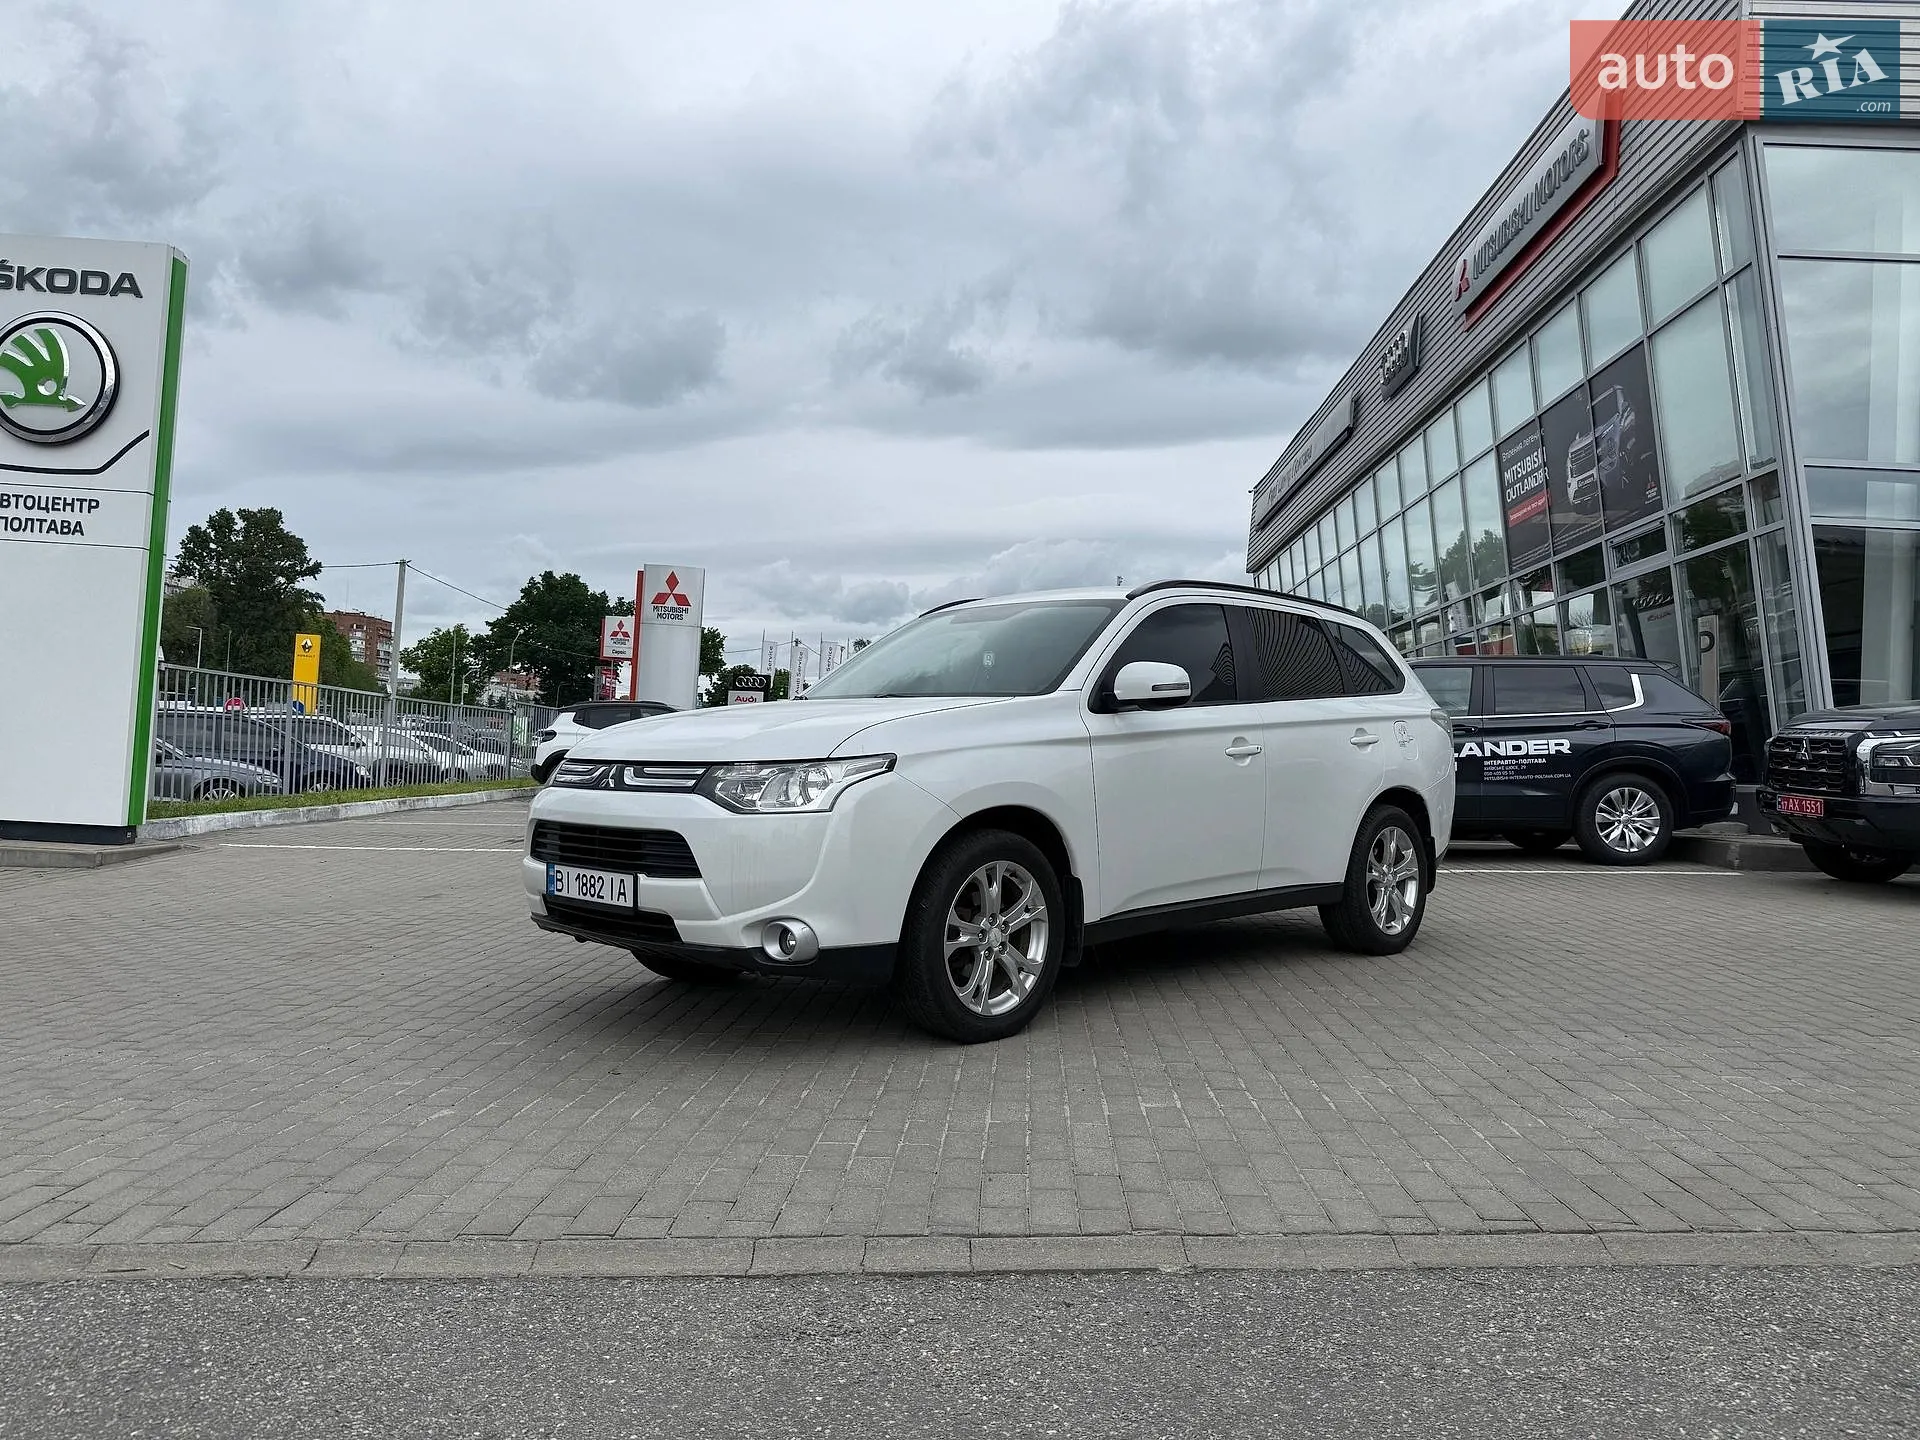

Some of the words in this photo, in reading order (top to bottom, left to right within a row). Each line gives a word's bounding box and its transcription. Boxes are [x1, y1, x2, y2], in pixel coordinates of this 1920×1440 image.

[1473, 192, 1534, 280] MITSUBISHI
[1534, 128, 1590, 212] MOTORS
[0, 516, 84, 536] ПОЛТАВА
[653, 605, 689, 615] MITSUBISHI
[656, 612, 684, 620] MOTORS
[796, 651, 804, 677] Service
[735, 695, 757, 704] Audi
[1789, 799, 1799, 811] AX
[1802, 800, 1820, 814] 1551
[556, 870, 569, 894] BI
[575, 873, 605, 899] 1882
[611, 877, 627, 903] IA
